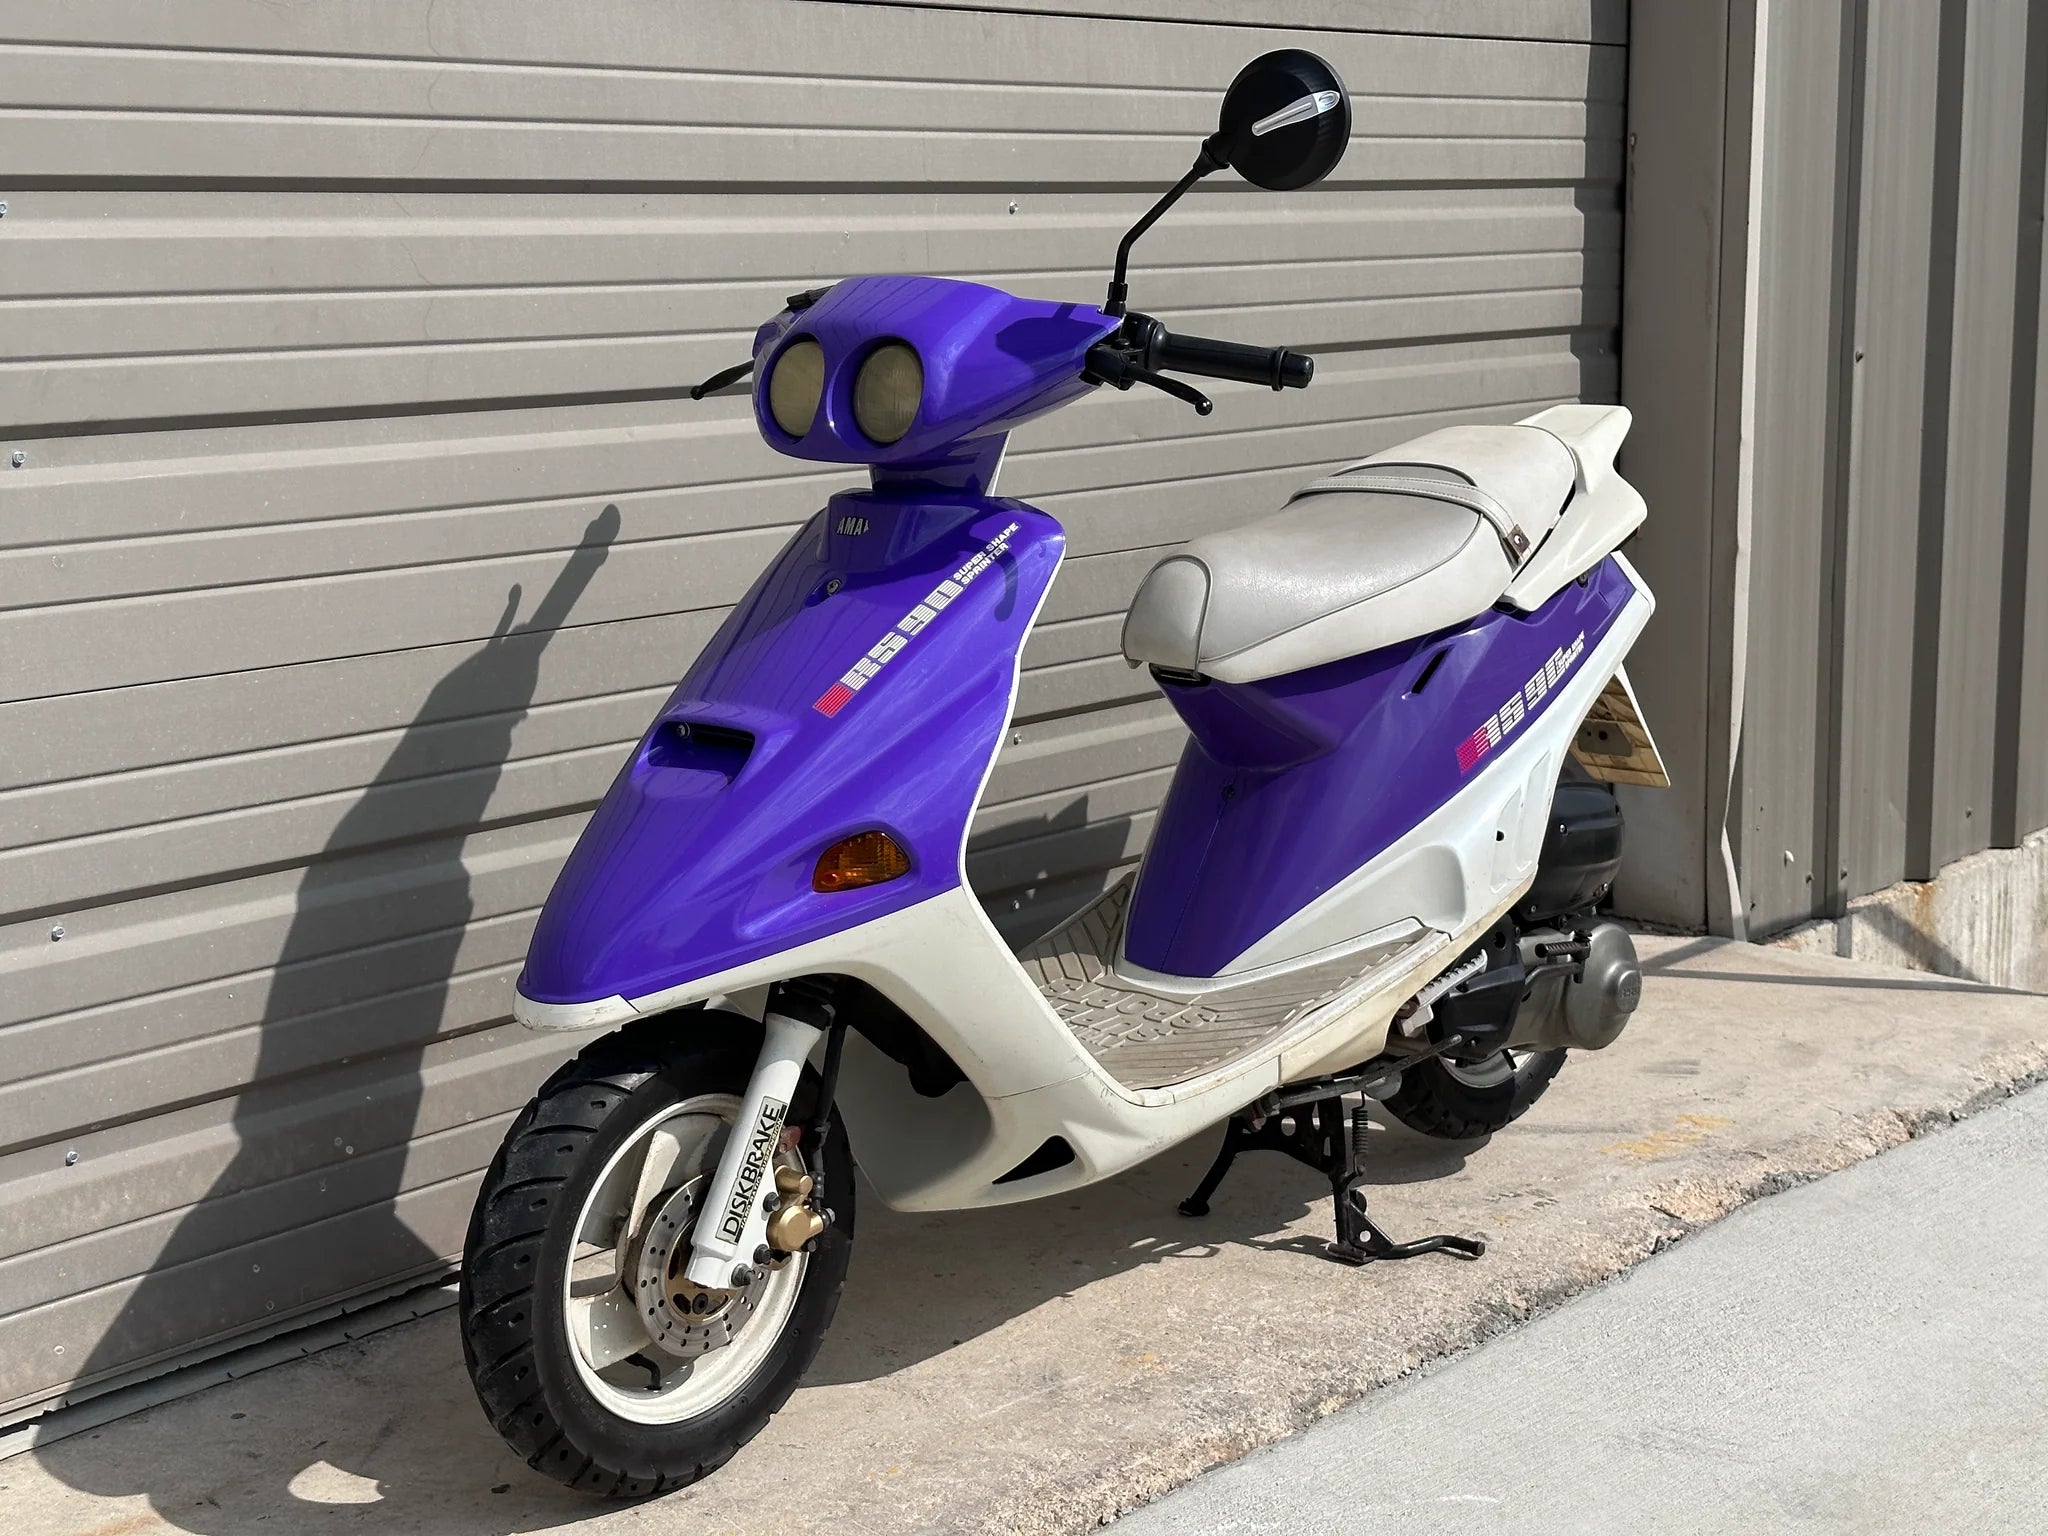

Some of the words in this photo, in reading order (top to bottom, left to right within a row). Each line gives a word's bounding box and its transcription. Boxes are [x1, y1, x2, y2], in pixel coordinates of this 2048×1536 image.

[953, 551, 987, 581] SUPER
[986, 522, 1019, 552] SHAPE
[960, 542, 1009, 585] SPRINTER
[722, 1104, 781, 1236] DISKBRAKE
